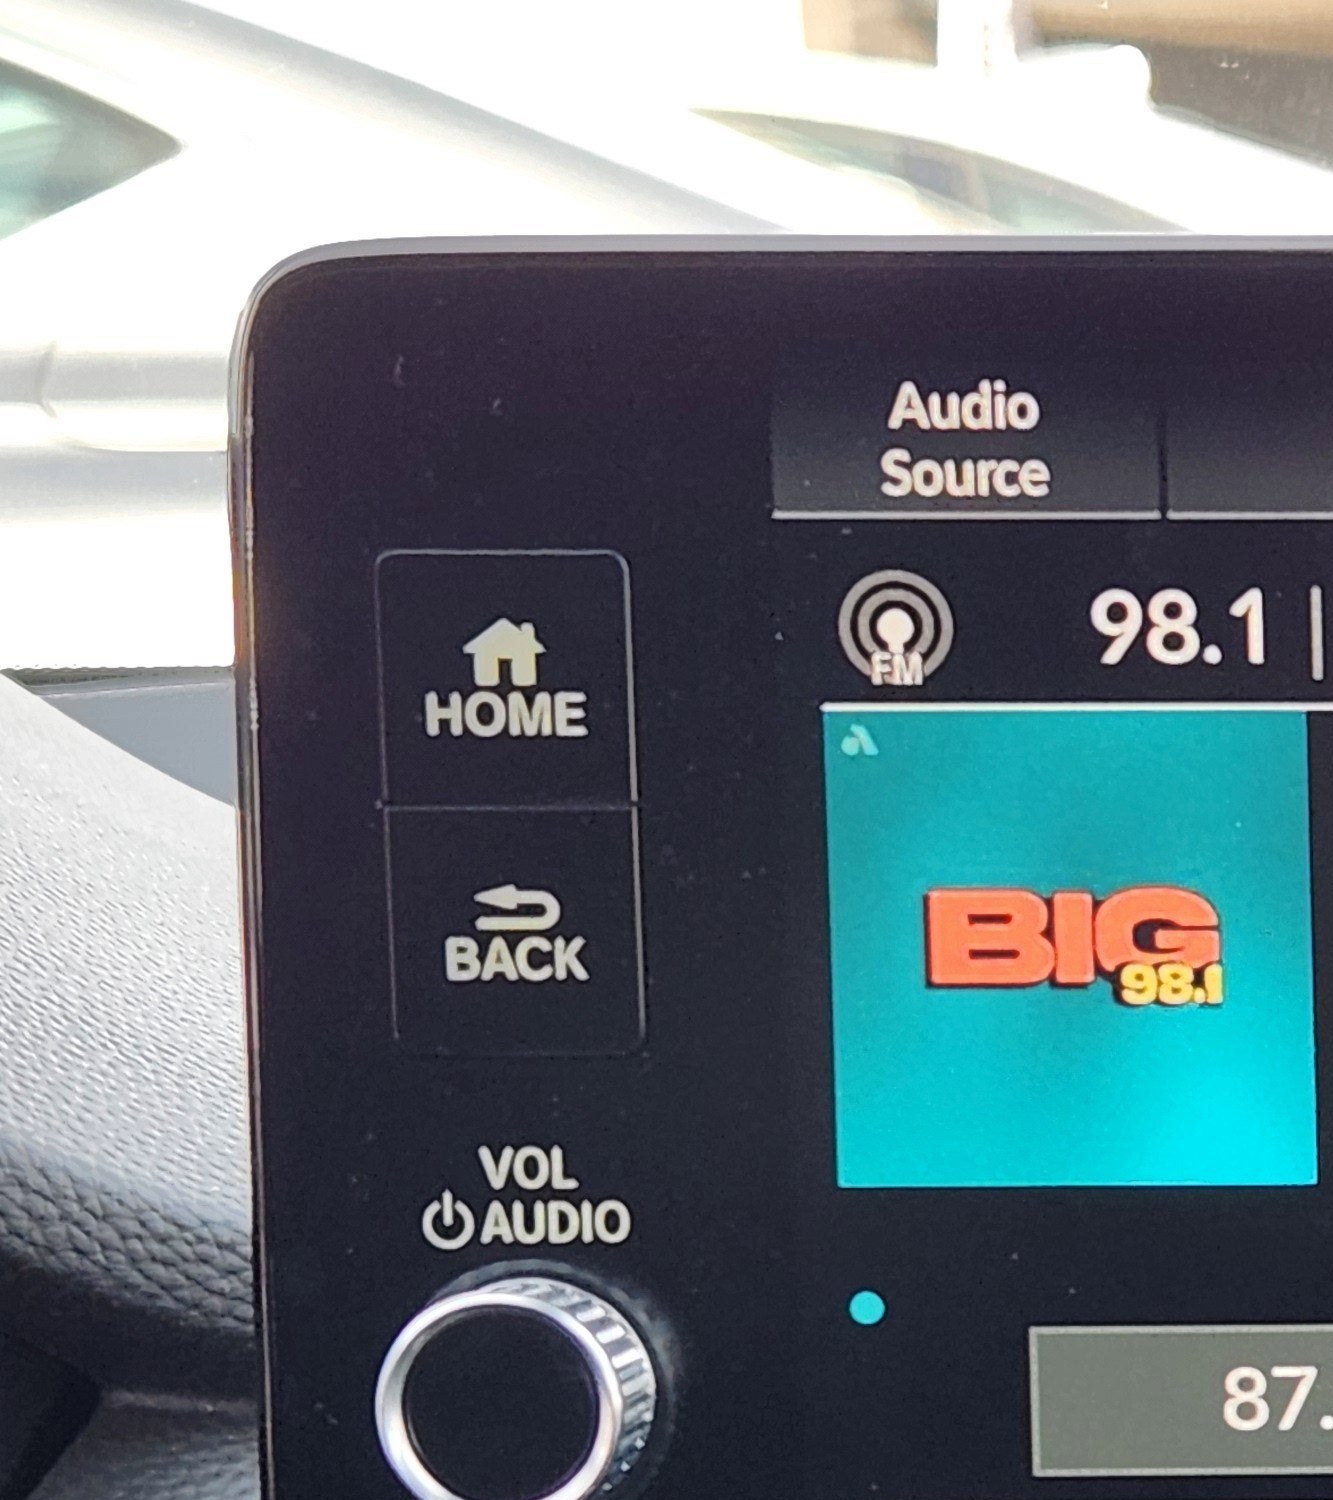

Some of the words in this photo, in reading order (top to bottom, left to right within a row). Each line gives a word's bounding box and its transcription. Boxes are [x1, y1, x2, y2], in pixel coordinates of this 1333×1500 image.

[887, 380, 1041, 432] Audio
[879, 449, 1051, 498] Source
[1090, 587, 1266, 665] 98.1
[424, 691, 589, 738] HOME
[445, 936, 590, 982] BACK
[926, 885, 1222, 988] BIG
[1118, 962, 1225, 1006] 98.1
[477, 1145, 580, 1191] VOL
[480, 1200, 632, 1246] AUDIO
